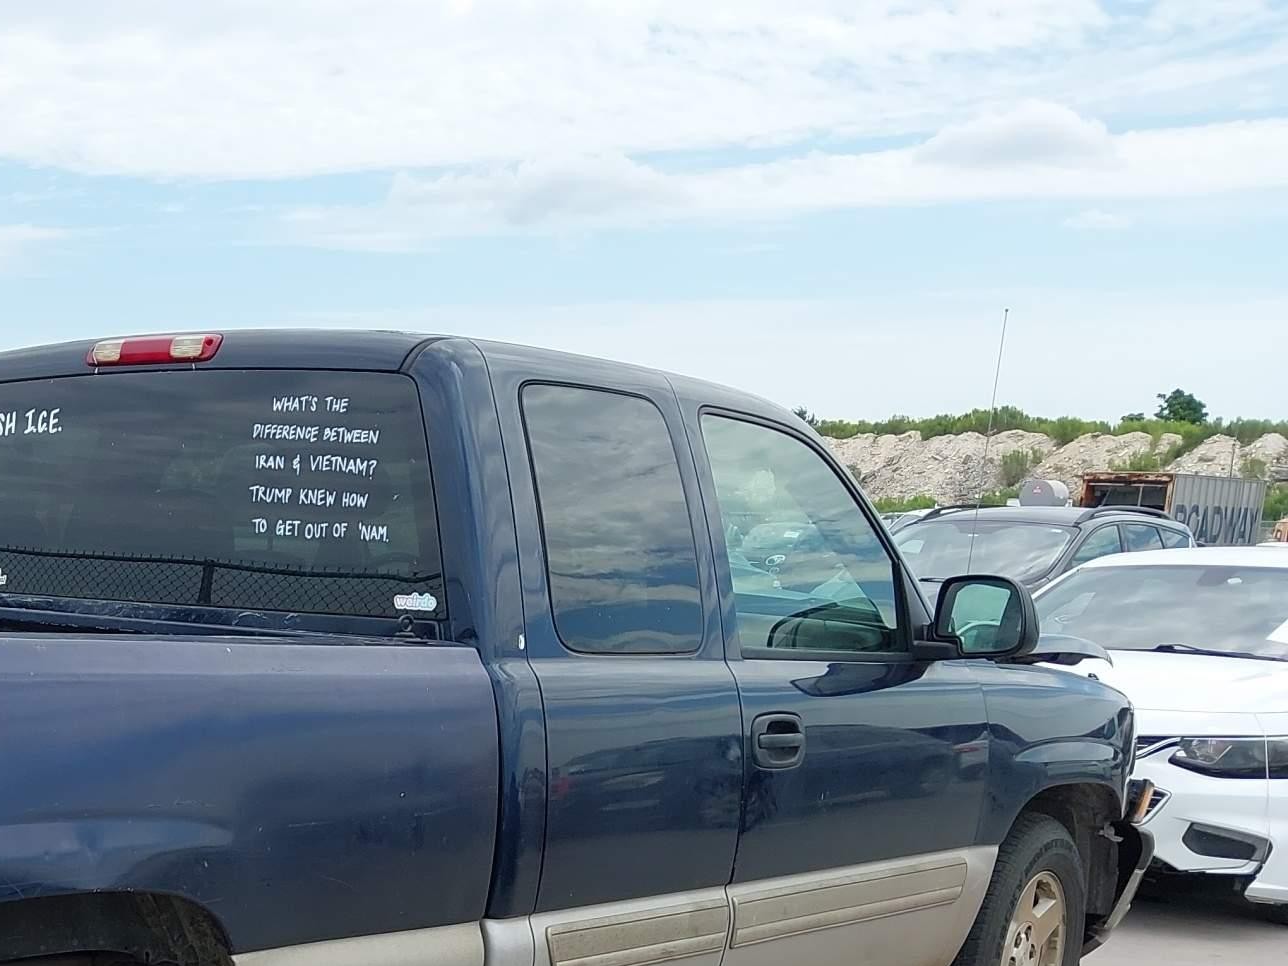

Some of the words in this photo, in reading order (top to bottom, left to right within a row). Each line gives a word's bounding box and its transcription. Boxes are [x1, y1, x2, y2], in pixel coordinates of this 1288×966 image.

[272, 396, 318, 412] WHAT'S
[325, 397, 349, 413] THE
[252, 423, 319, 442] DIFFERENCE
[323, 426, 380, 444] BETWEEN
[255, 454, 285, 470] IRAN
[292, 454, 301, 476] &
[310, 454, 378, 480] VIETNAM?
[249, 485, 292, 504] TRUMP
[298, 488, 337, 508] KNEW
[342, 491, 369, 508] HOW
[252, 518, 268, 534] TO
[275, 520, 301, 537] GET
[304, 523, 329, 540] OUT
[332, 522, 349, 538] OF
[358, 521, 390, 543] 'NAM.
[395, 593, 436, 609] weirdo
